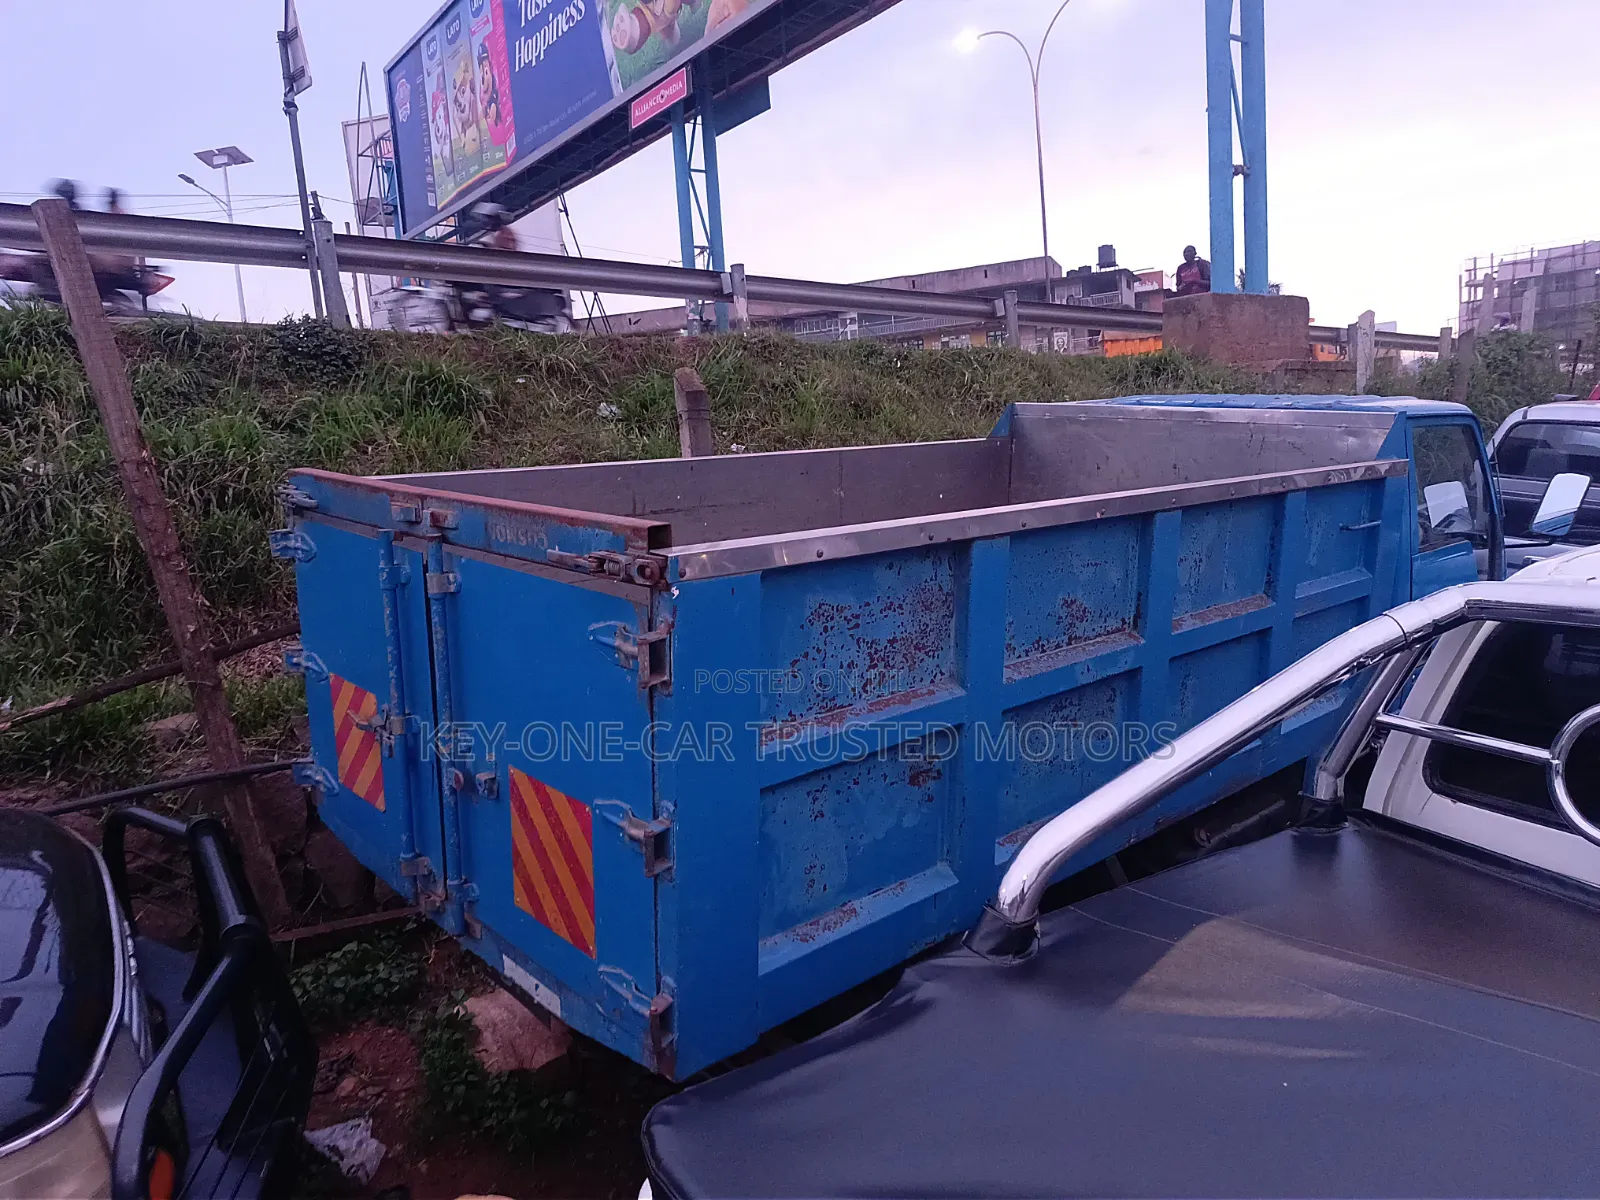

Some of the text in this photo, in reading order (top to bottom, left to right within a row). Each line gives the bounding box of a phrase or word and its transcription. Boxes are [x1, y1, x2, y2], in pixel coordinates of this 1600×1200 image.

[446, 19, 460, 39] LATO
[518, 0, 552, 28] Tas
[515, 0, 586, 72] Happiness
[635, 80, 683, 118] ALLIANCE MEDIA
